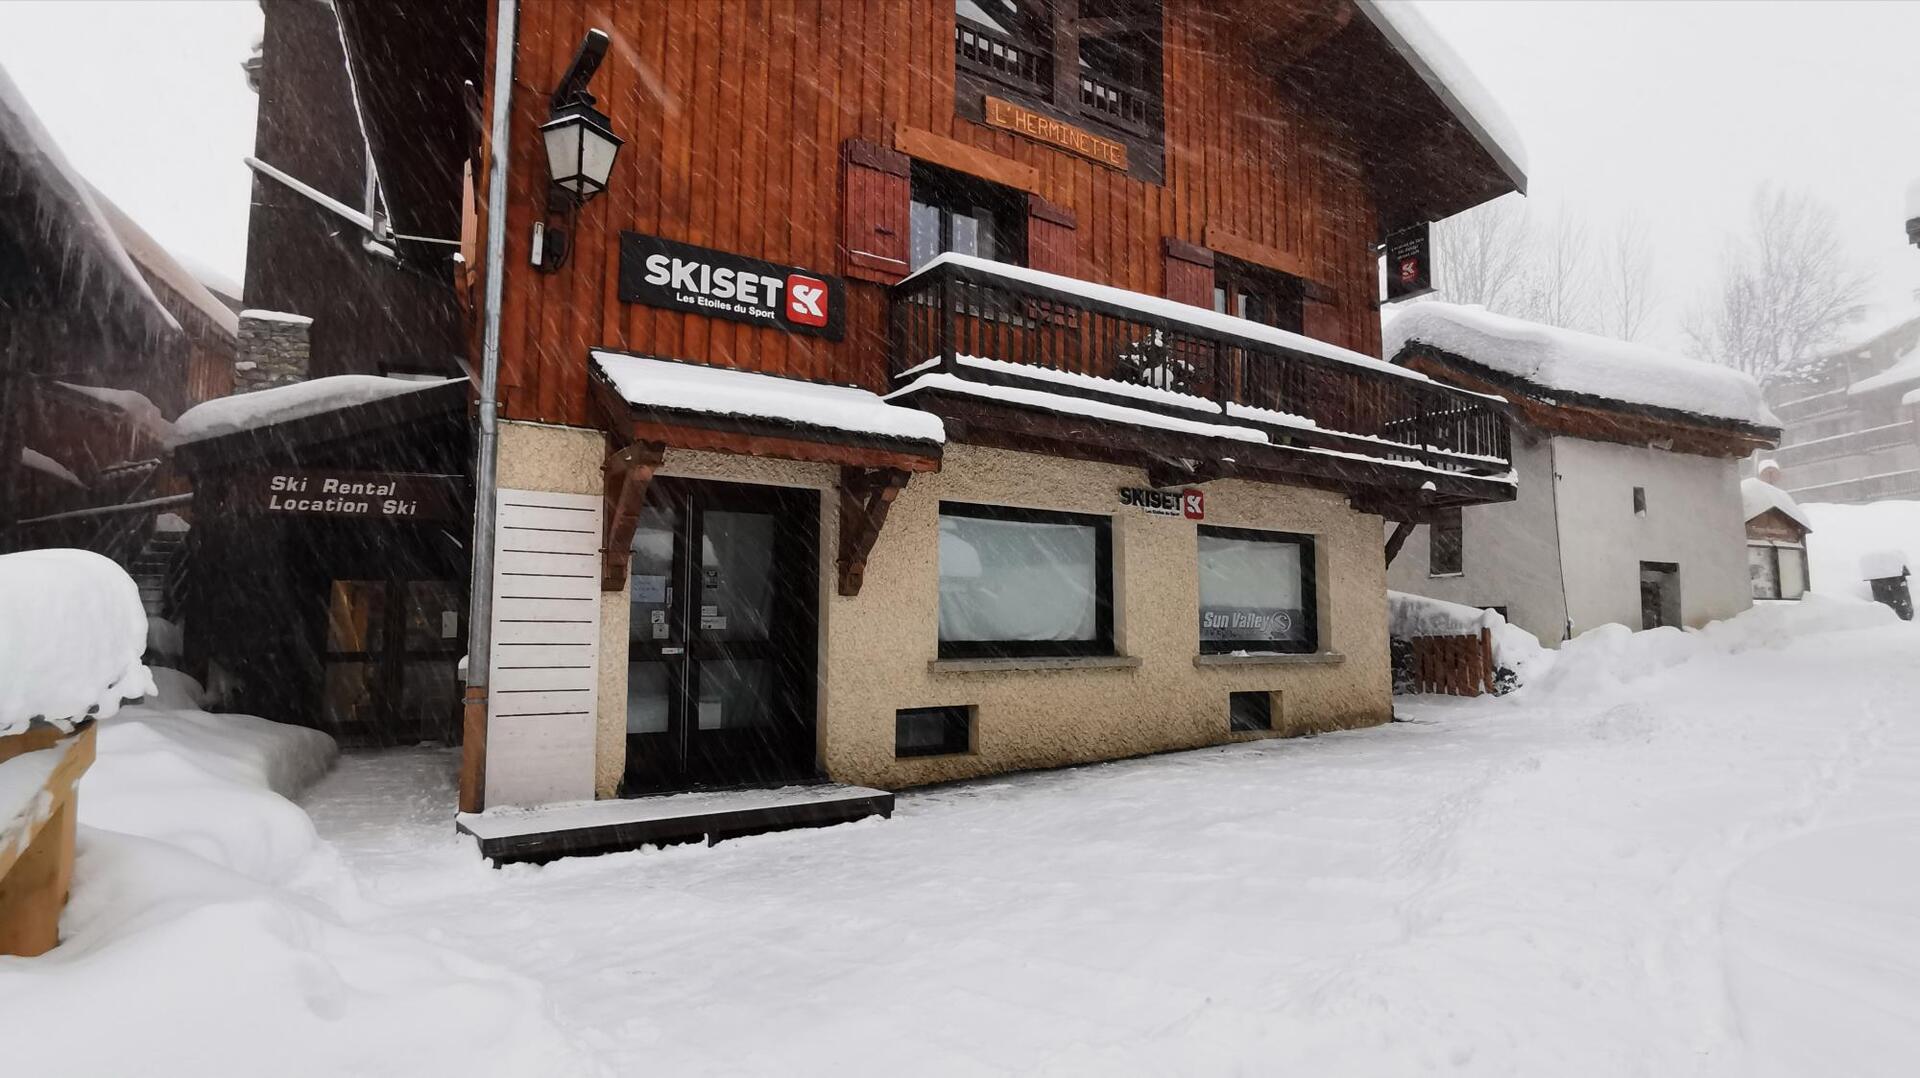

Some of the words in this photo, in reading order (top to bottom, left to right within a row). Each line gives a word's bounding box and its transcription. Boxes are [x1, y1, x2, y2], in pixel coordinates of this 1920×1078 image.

[995, 103, 1120, 164] L'HERMINETTE
[644, 254, 784, 308] SKISET
[676, 292, 695, 304] Les
[697, 296, 732, 311] Etoiles
[734, 303, 747, 314] du
[749, 307, 775, 320] Sport
[270, 475, 308, 492] Ski
[322, 478, 396, 496] Rental
[269, 495, 369, 513] Location
[382, 499, 417, 515] Ski
[1119, 487, 1184, 511] SKISET
[1203, 611, 1230, 628] Sun
[1232, 612, 1270, 632] Valley
